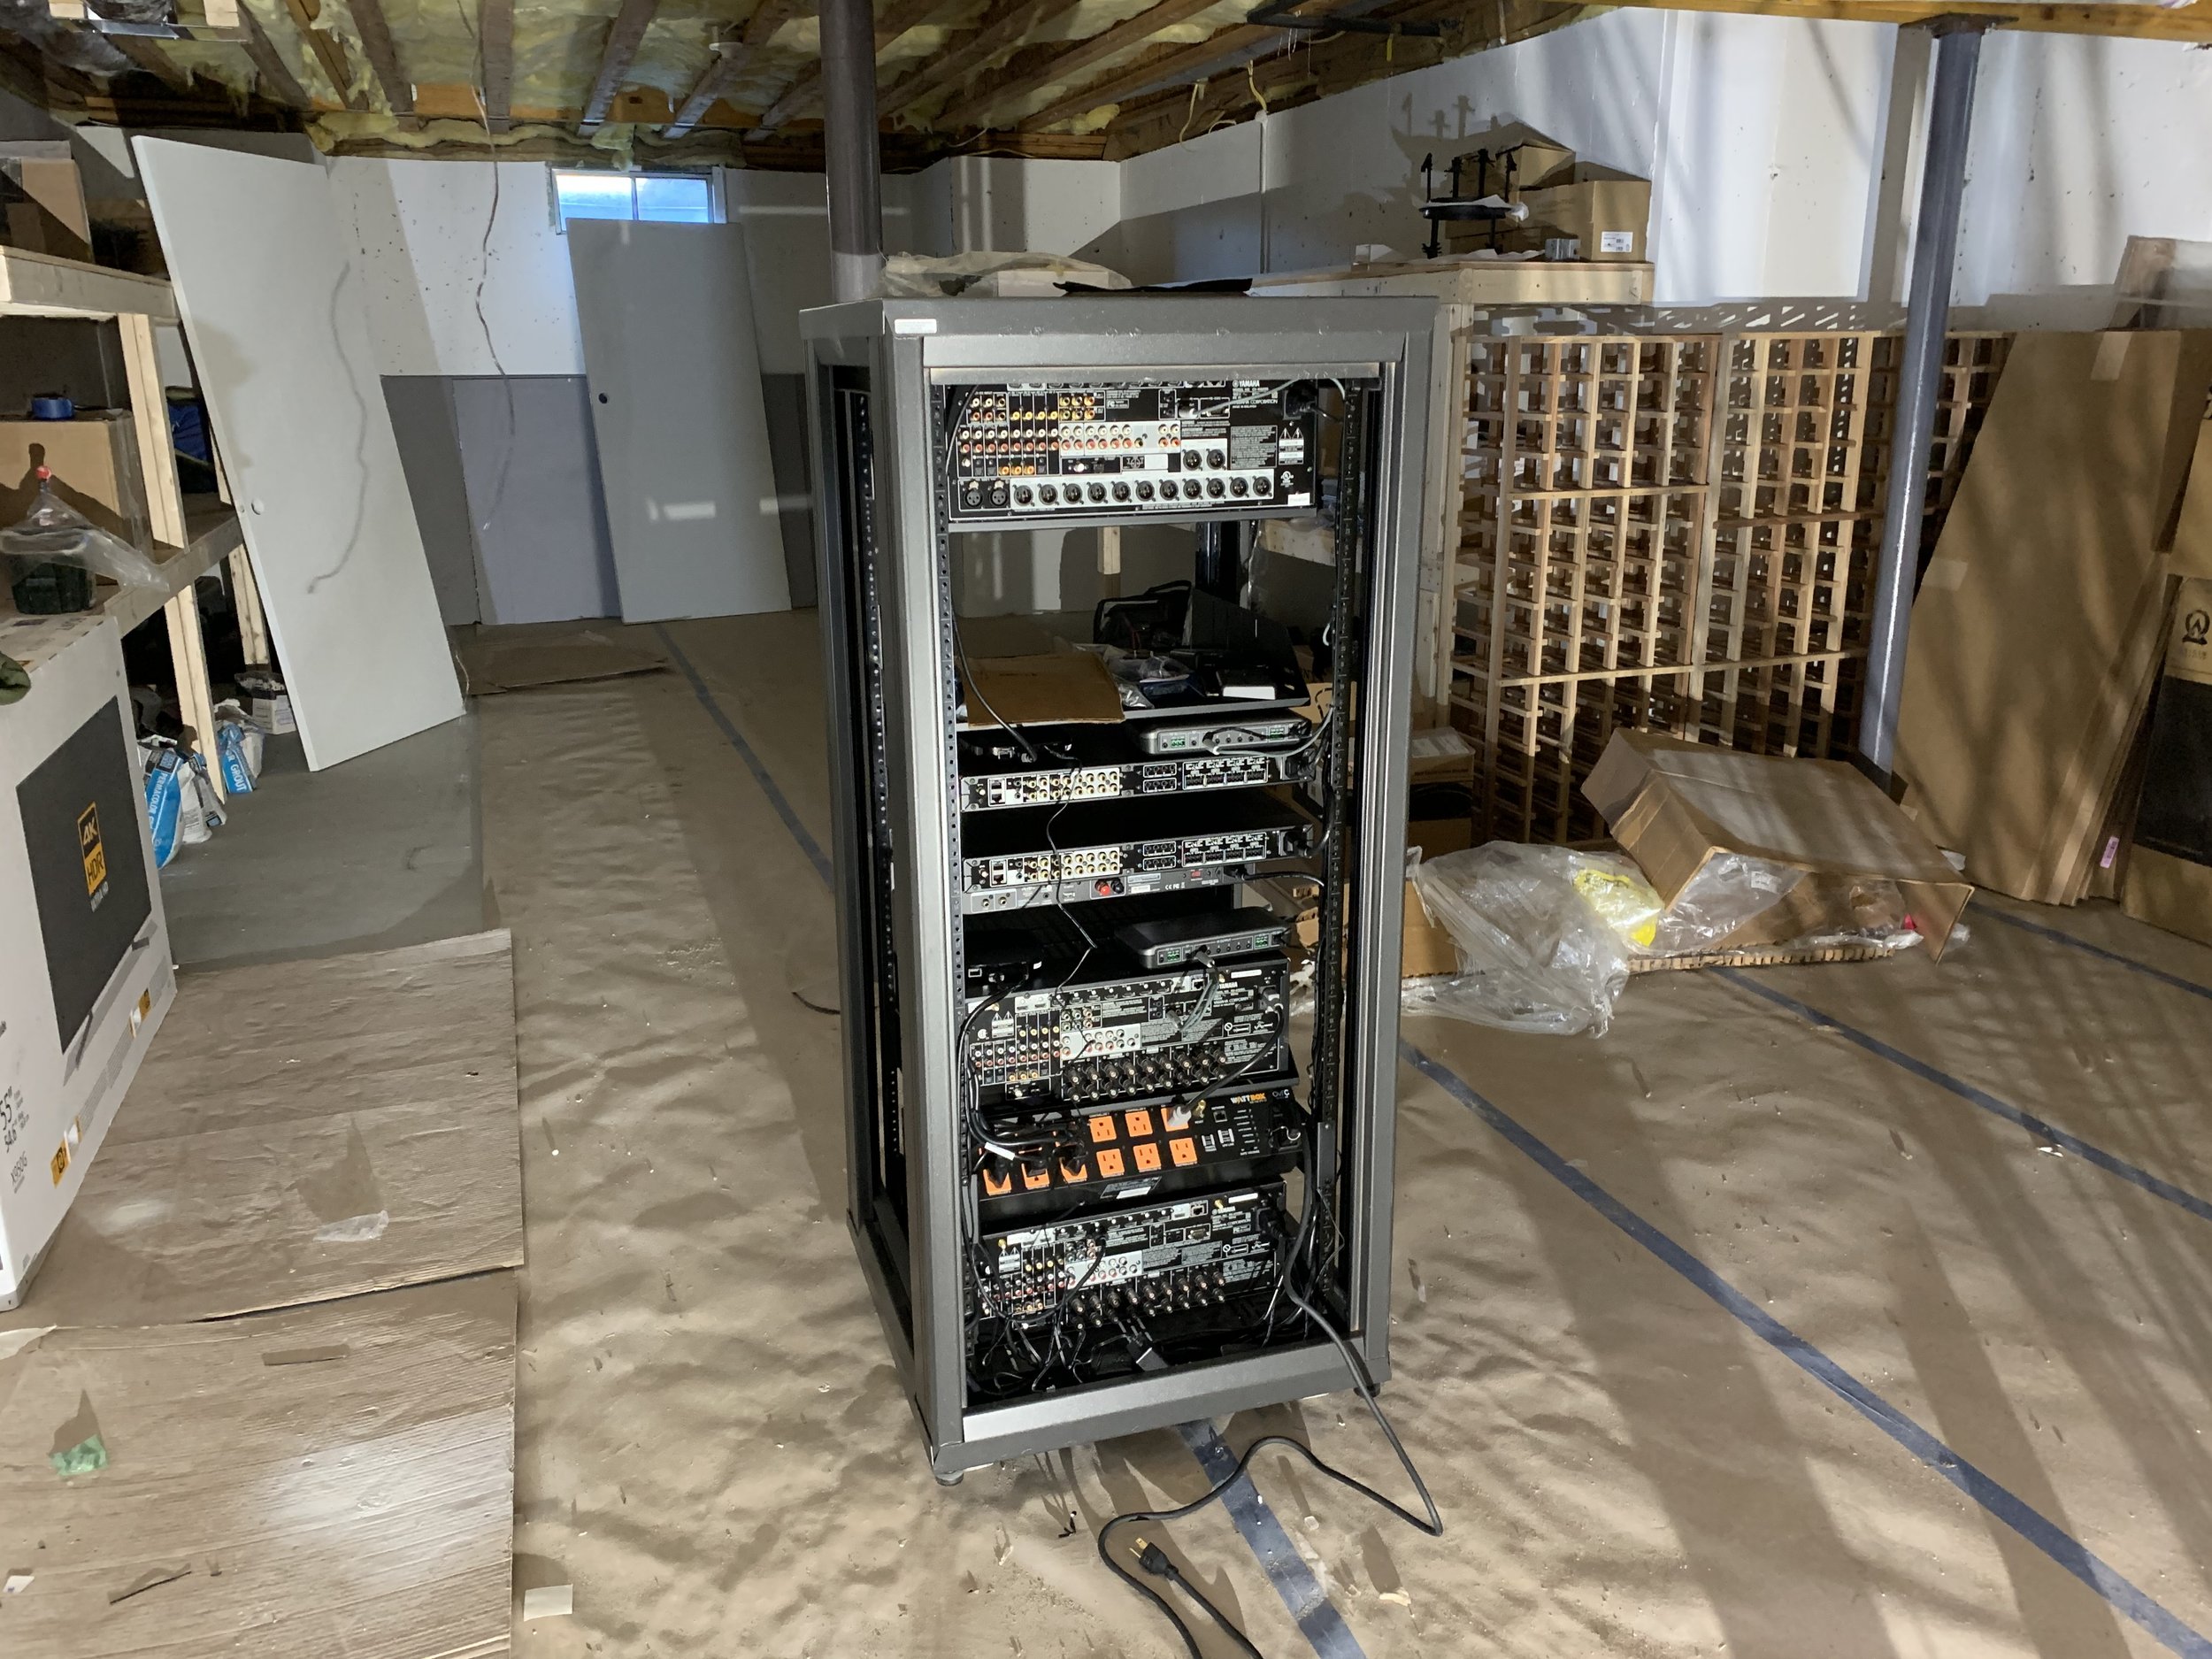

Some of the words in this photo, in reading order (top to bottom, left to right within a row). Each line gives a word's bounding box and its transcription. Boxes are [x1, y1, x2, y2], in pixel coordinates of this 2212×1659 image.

[230, 764, 248, 792] GROUT
[83, 816, 97, 845] 4K
[88, 851, 104, 886] HDR
[1230, 1093, 1265, 1103] WATTBOX
